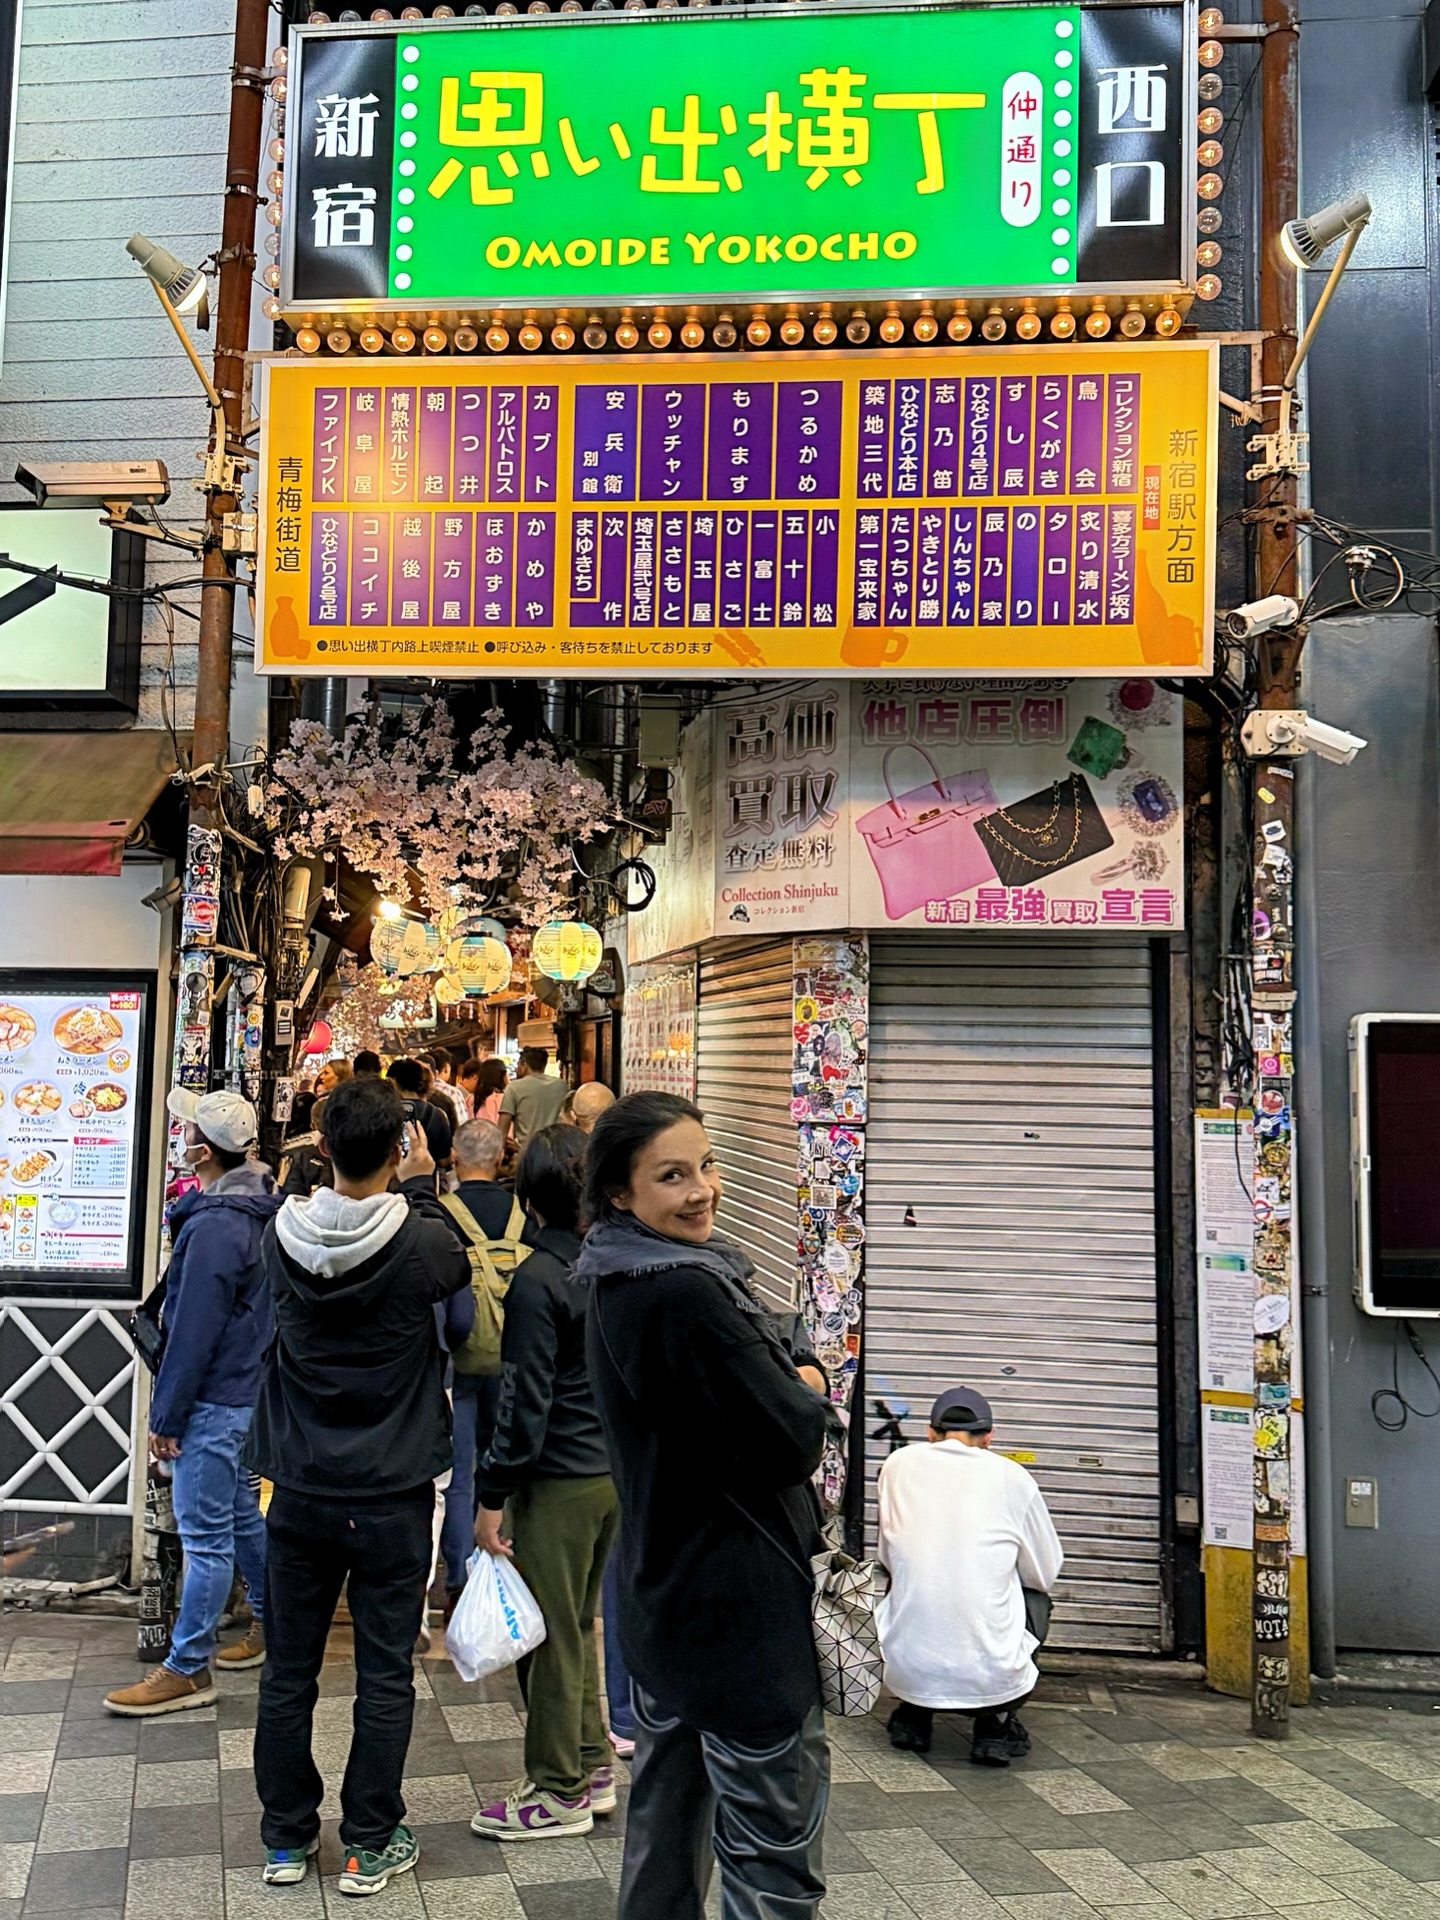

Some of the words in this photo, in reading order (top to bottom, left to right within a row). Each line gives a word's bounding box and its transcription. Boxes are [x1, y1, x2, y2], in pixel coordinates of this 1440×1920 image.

[313, 92, 381, 249] 新宿
[428, 66, 985, 206] 思い出横丁
[1006, 91, 1037, 210] 仲通り
[1095, 65, 1168, 227] 西口
[485, 235, 670, 270] OMOIDE
[684, 230, 918, 267] YOKOCHO
[319, 394, 339, 495] ファイブK
[354, 393, 375, 494] 岐阜屋
[391, 393, 410, 495] 情熱ホルモン
[424, 393, 445, 494] 朝起
[460, 394, 481, 494] つつ井
[496, 393, 515, 494] アルバトロス
[533, 392, 552, 494] カブト
[582, 451, 599, 494] 別館
[604, 391, 625, 494] 安兵衛
[663, 390, 683, 496] ウッチャン
[730, 389, 750, 493] もります
[798, 388, 819, 492] つるかめ
[863, 385, 885, 492] 築地三代
[897, 385, 920, 491] ひなどり本店
[933, 384, 955, 489] 志乃笛
[968, 384, 990, 490] ひなどり4号店
[1003, 383, 1026, 487] すし辰
[1040, 382, 1061, 487] らくがき
[1075, 381, 1098, 487] 鳥会
[1112, 380, 1133, 486] コレクション新宿
[275, 457, 303, 572] 青梅街道
[1144, 477, 1160, 520] 現在地
[1167, 430, 1198, 583] 新宿駅方面
[318, 518, 339, 620] ひなどり2号店
[360, 519, 379, 619] ココイチ
[401, 518, 421, 619] 越後屋
[443, 518, 463, 619] 野方屋
[484, 519, 504, 620] ほおずき
[526, 518, 545, 618] かめや
[575, 518, 594, 592] まゆきち
[603, 518, 624, 620] 次作
[632, 518, 653, 621] 埼玉屋弐号店
[663, 518, 683, 620] ささもと
[692, 517, 714, 621] 埼玉屋
[724, 518, 744, 620] ひさご
[752, 523, 774, 621] 一富士
[783, 516, 804, 621] 五十鈴
[813, 516, 835, 623] 小松
[857, 515, 879, 621] 第一宝来家
[889, 514, 910, 619] たっちゃん
[918, 514, 942, 619] やきとり勝
[951, 514, 972, 619] しんちゃん
[982, 513, 1005, 620] 辰乃家
[1016, 513, 1036, 619] のり
[1048, 512, 1067, 619] タロー
[1078, 512, 1100, 619] 炙り清水
[1110, 511, 1133, 619] 喜多方ラーメン坂内
[329, 640, 479, 654] 思い出横丁内路上喫煙禁止
[497, 640, 713, 655] 呼び込み・客待ちを禁止しております
[726, 694, 838, 762] 高価
[862, 697, 1066, 744] 他店圧倒
[726, 768, 838, 834] 買取
[721, 887, 781, 902] Collection
[784, 882, 838, 902] Shinjuku
[724, 835, 834, 873] 査定無料
